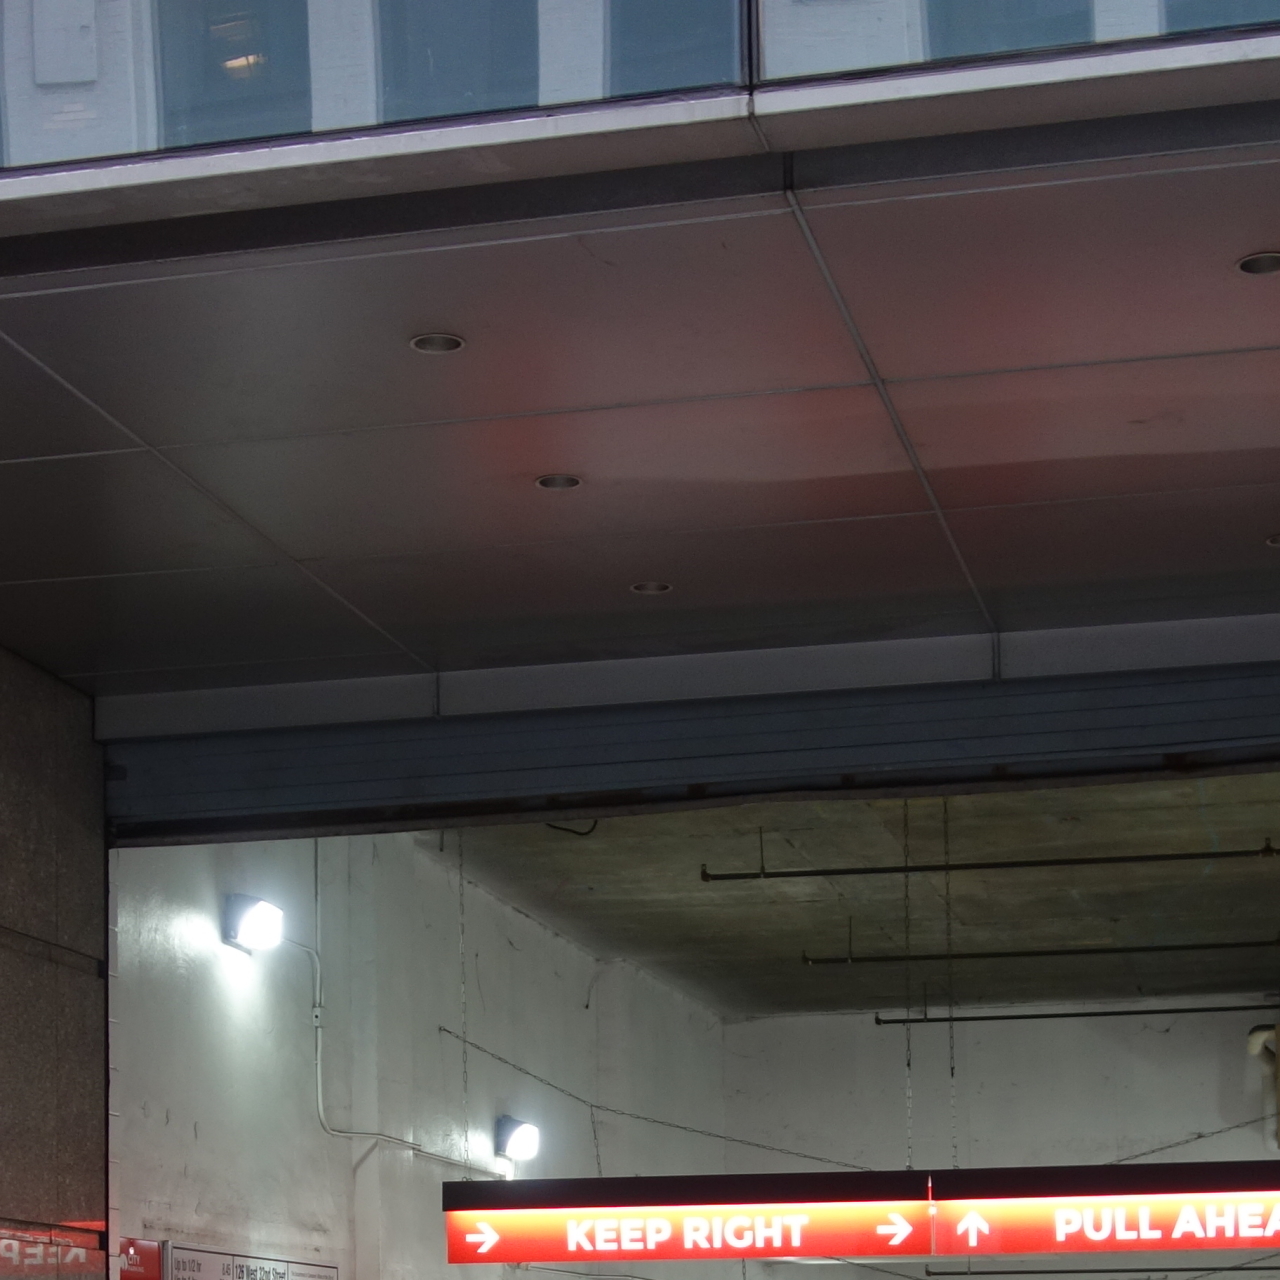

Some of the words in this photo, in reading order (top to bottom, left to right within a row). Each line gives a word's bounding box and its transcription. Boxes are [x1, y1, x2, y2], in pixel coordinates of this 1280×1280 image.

[566, 1217, 672, 1251] KEEP
[682, 1214, 809, 1249] RIGHT
[1054, 1206, 1162, 1242] PULL
[174, 1258, 181, 1272] Up
[181, 1258, 187, 1271] to
[188, 1259, 196, 1272] 1/2
[196, 1262, 202, 1273] hr
[235, 1264, 245, 1280] 126
[245, 1265, 258, 1280] West
